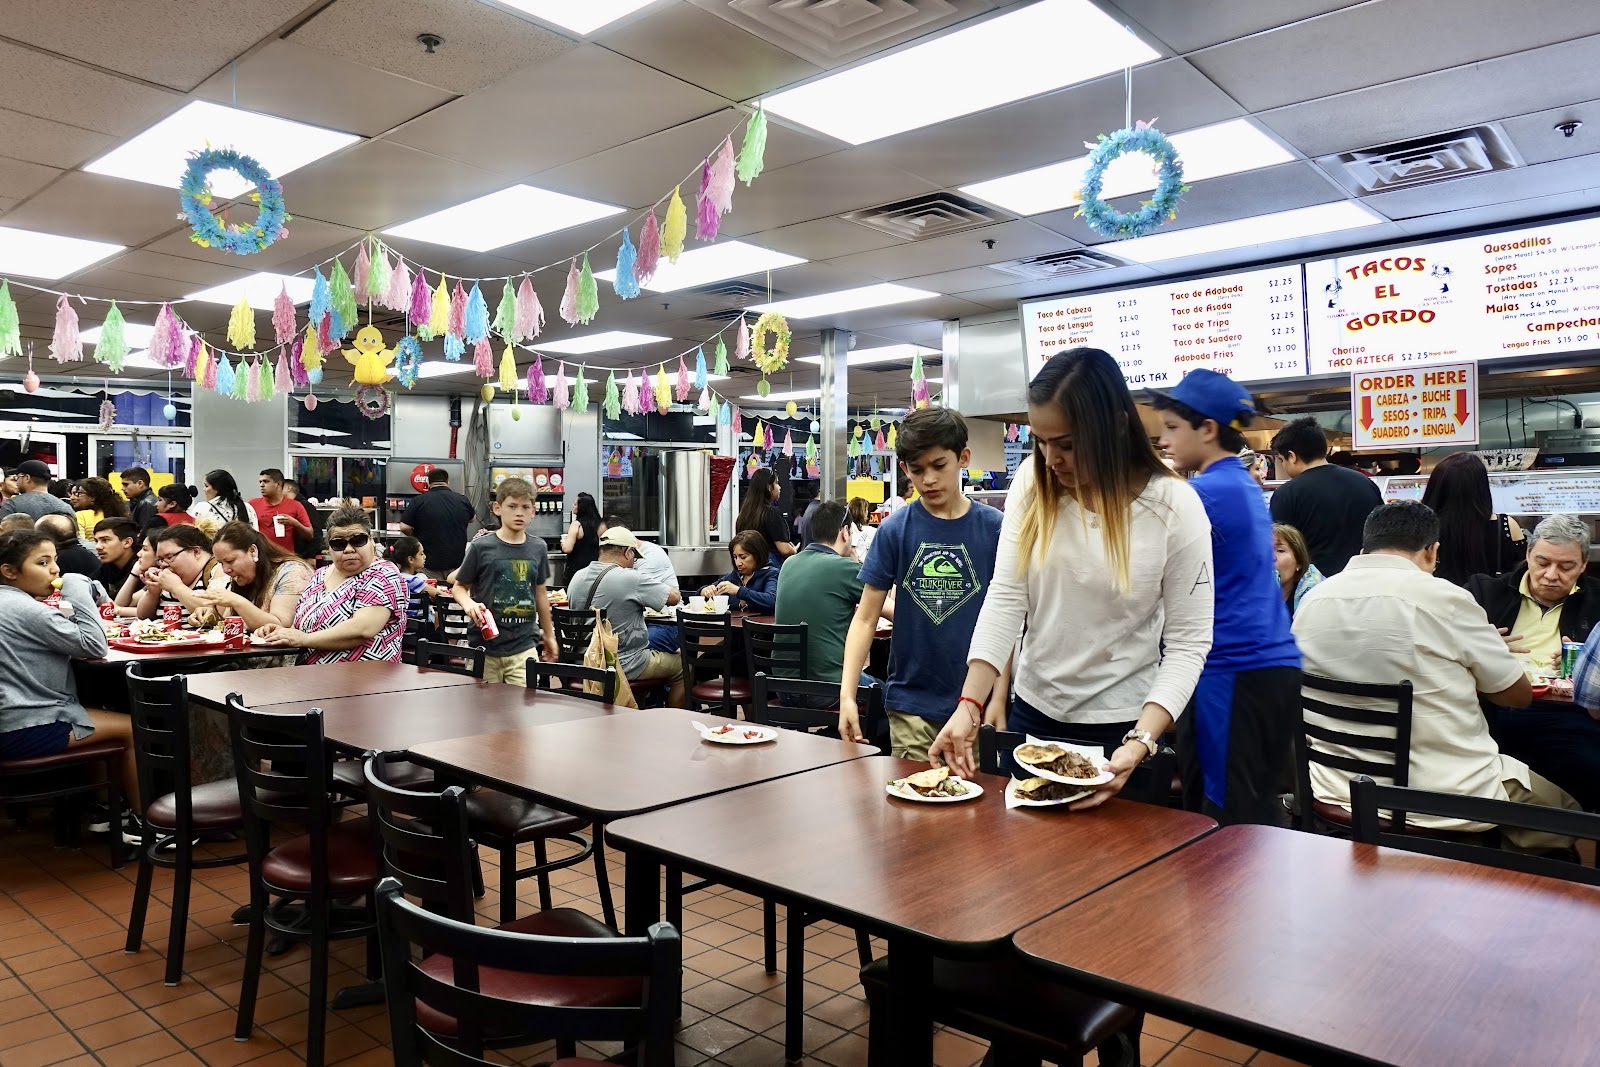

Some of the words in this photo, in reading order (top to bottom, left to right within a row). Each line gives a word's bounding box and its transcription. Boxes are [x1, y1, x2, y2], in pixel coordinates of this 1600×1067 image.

[1484, 237, 1552, 254] Quesadillas
[1346, 257, 1426, 280] TACOS
[1485, 263, 1517, 274] Sopes
[1206, 285, 1243, 296] Adobada
[1269, 278, 1292, 287] $2.25
[1375, 284, 1400, 299] EL
[1486, 281, 1538, 294] Tostadas
[1549, 276, 1574, 286] $2.25
[1117, 300, 1137, 308] $2.25
[1206, 302, 1232, 312] Asada
[1270, 294, 1293, 303] $2.25
[1486, 303, 1519, 313] Mulas
[1530, 300, 1556, 308] $4.50
[1068, 321, 1094, 329] Lengua
[1207, 319, 1229, 328] Tripa
[1271, 312, 1294, 320] $2.25
[1346, 309, 1436, 331] GORDO
[1208, 334, 1242, 343] Suadero
[1272, 327, 1295, 335] $2.25
[1558, 334, 1588, 343] $15.00
[1174, 353, 1210, 362] Adobada
[1214, 351, 1234, 359] Fries
[1267, 344, 1296, 353] $13.00
[1332, 346, 1365, 355] Chorizo
[1274, 361, 1297, 369] $2.25
[1328, 358, 1352, 368] TACO
[1356, 354, 1394, 365] AZTECA
[1401, 352, 1428, 361] $2.25
[1124, 375, 1146, 383] PLUS
[1149, 372, 1168, 381] TAX
[1360, 374, 1415, 391] ORDER
[1424, 370, 1466, 386] HERE
[1376, 393, 1409, 406] CABEZA
[1422, 390, 1451, 403] BUCHE
[1383, 409, 1409, 422] SESOS
[1422, 407, 1447, 420] TRIPA
[1372, 426, 1410, 439] SUADERO
[1422, 423, 1456, 436] LENGUA
[919, 579, 963, 589] QUIKSILVER
